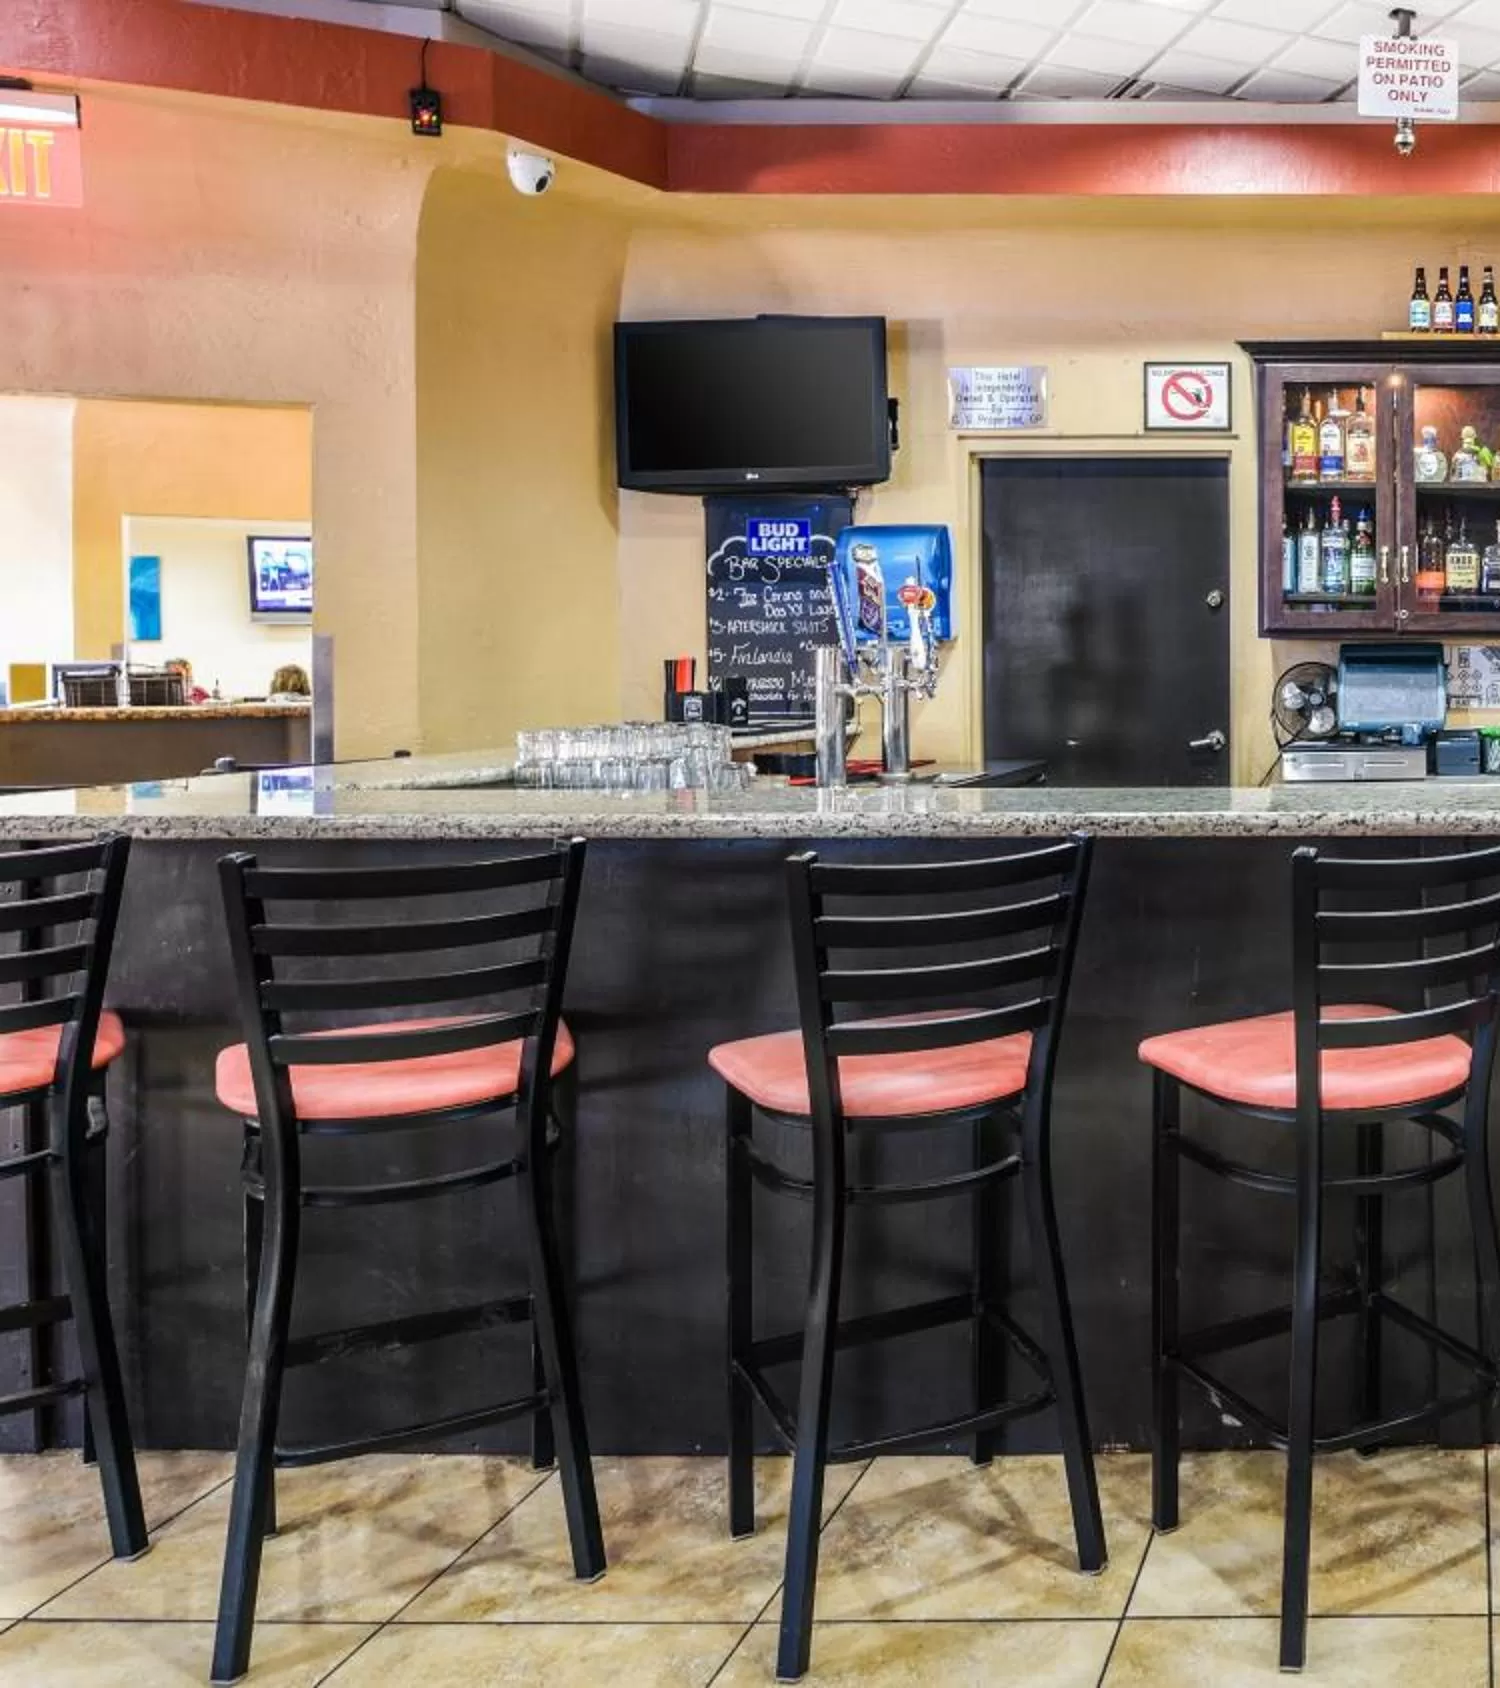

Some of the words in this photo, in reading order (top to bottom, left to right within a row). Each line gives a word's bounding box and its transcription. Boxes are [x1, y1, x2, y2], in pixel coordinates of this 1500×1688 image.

[1374, 41, 1445, 56] SMOKING
[1366, 56, 1451, 73] PERMITTED
[1372, 71, 1395, 85] ON
[1400, 74, 1444, 88] PATIO
[1388, 89, 1428, 103] ONLY
[758, 523, 799, 537] BUD
[751, 537, 807, 552] LIGHT
